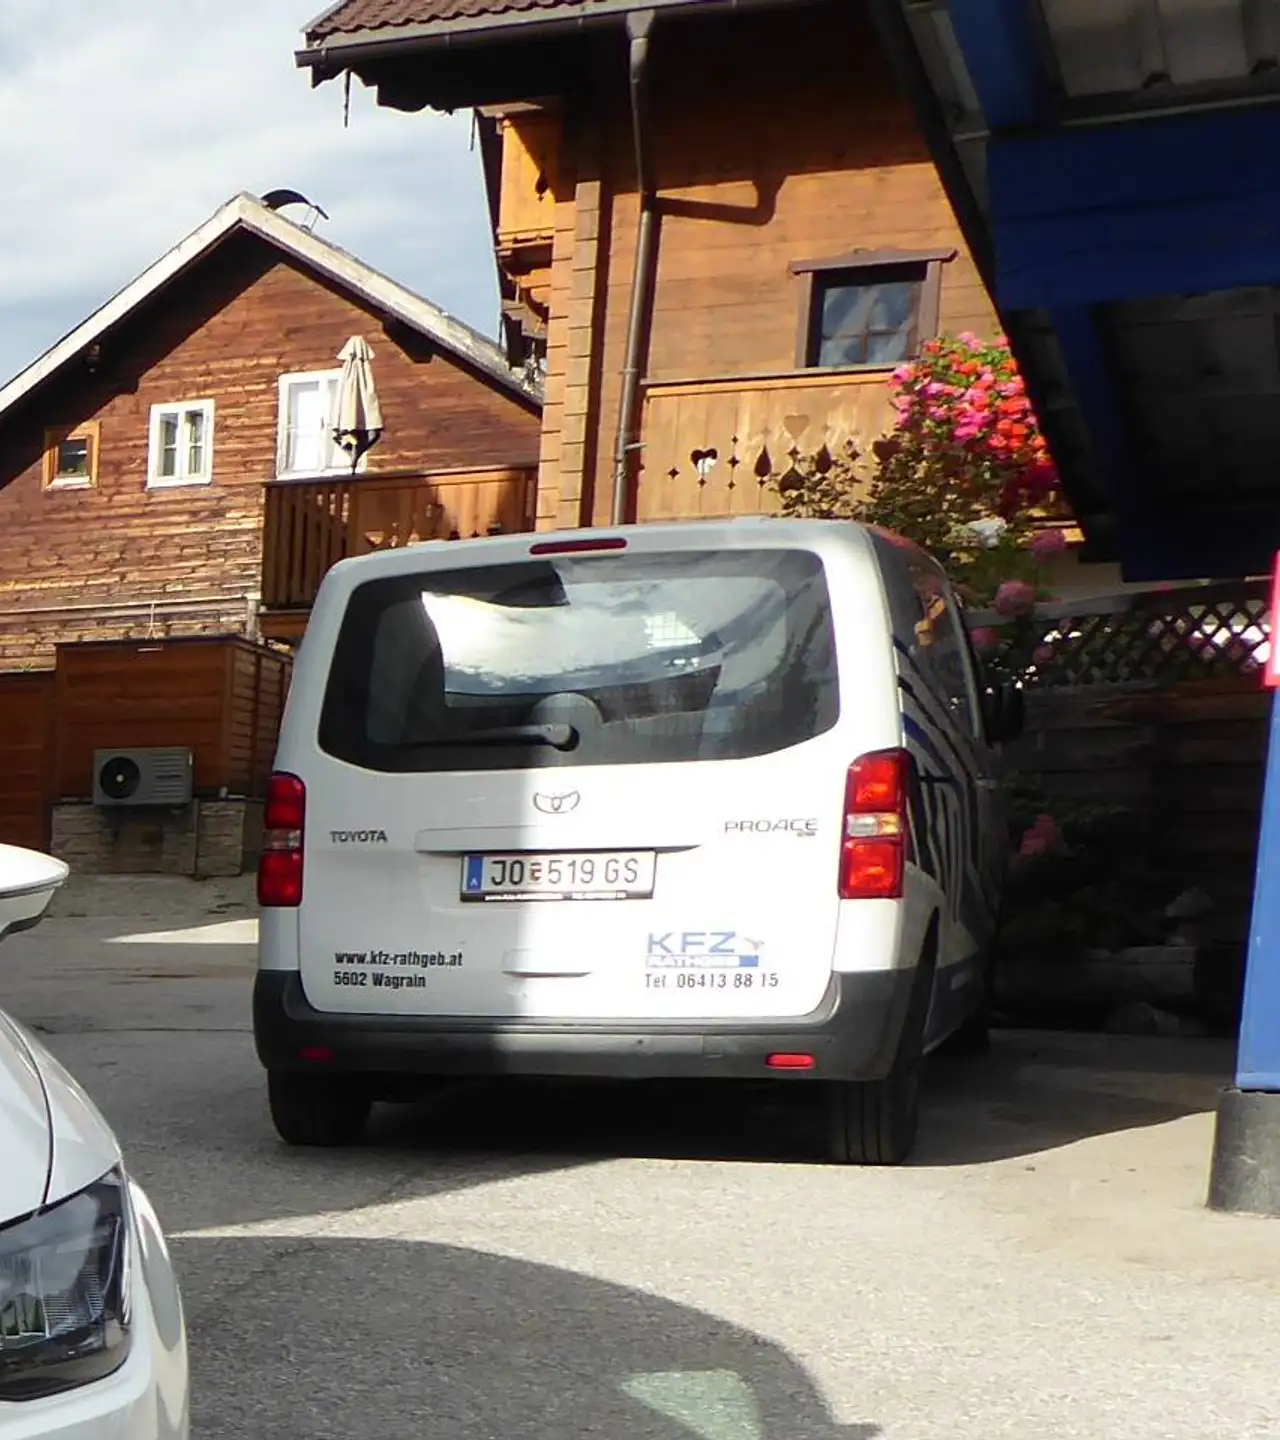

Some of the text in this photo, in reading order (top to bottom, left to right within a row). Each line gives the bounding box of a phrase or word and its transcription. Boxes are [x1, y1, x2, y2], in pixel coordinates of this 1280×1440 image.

[724, 818, 818, 833] PROACE
[330, 830, 388, 843] TOYOTA
[491, 860, 524, 886] JO
[548, 859, 595, 884] 519
[604, 858, 638, 883] GS
[647, 931, 737, 954] KFZ
[335, 951, 463, 968] www.kfz-rathgeb.at
[334, 971, 426, 989] 5602 Wagrain
[677, 973, 726, 988] 06413
[734, 973, 753, 988] 88
[761, 972, 779, 987] 15
